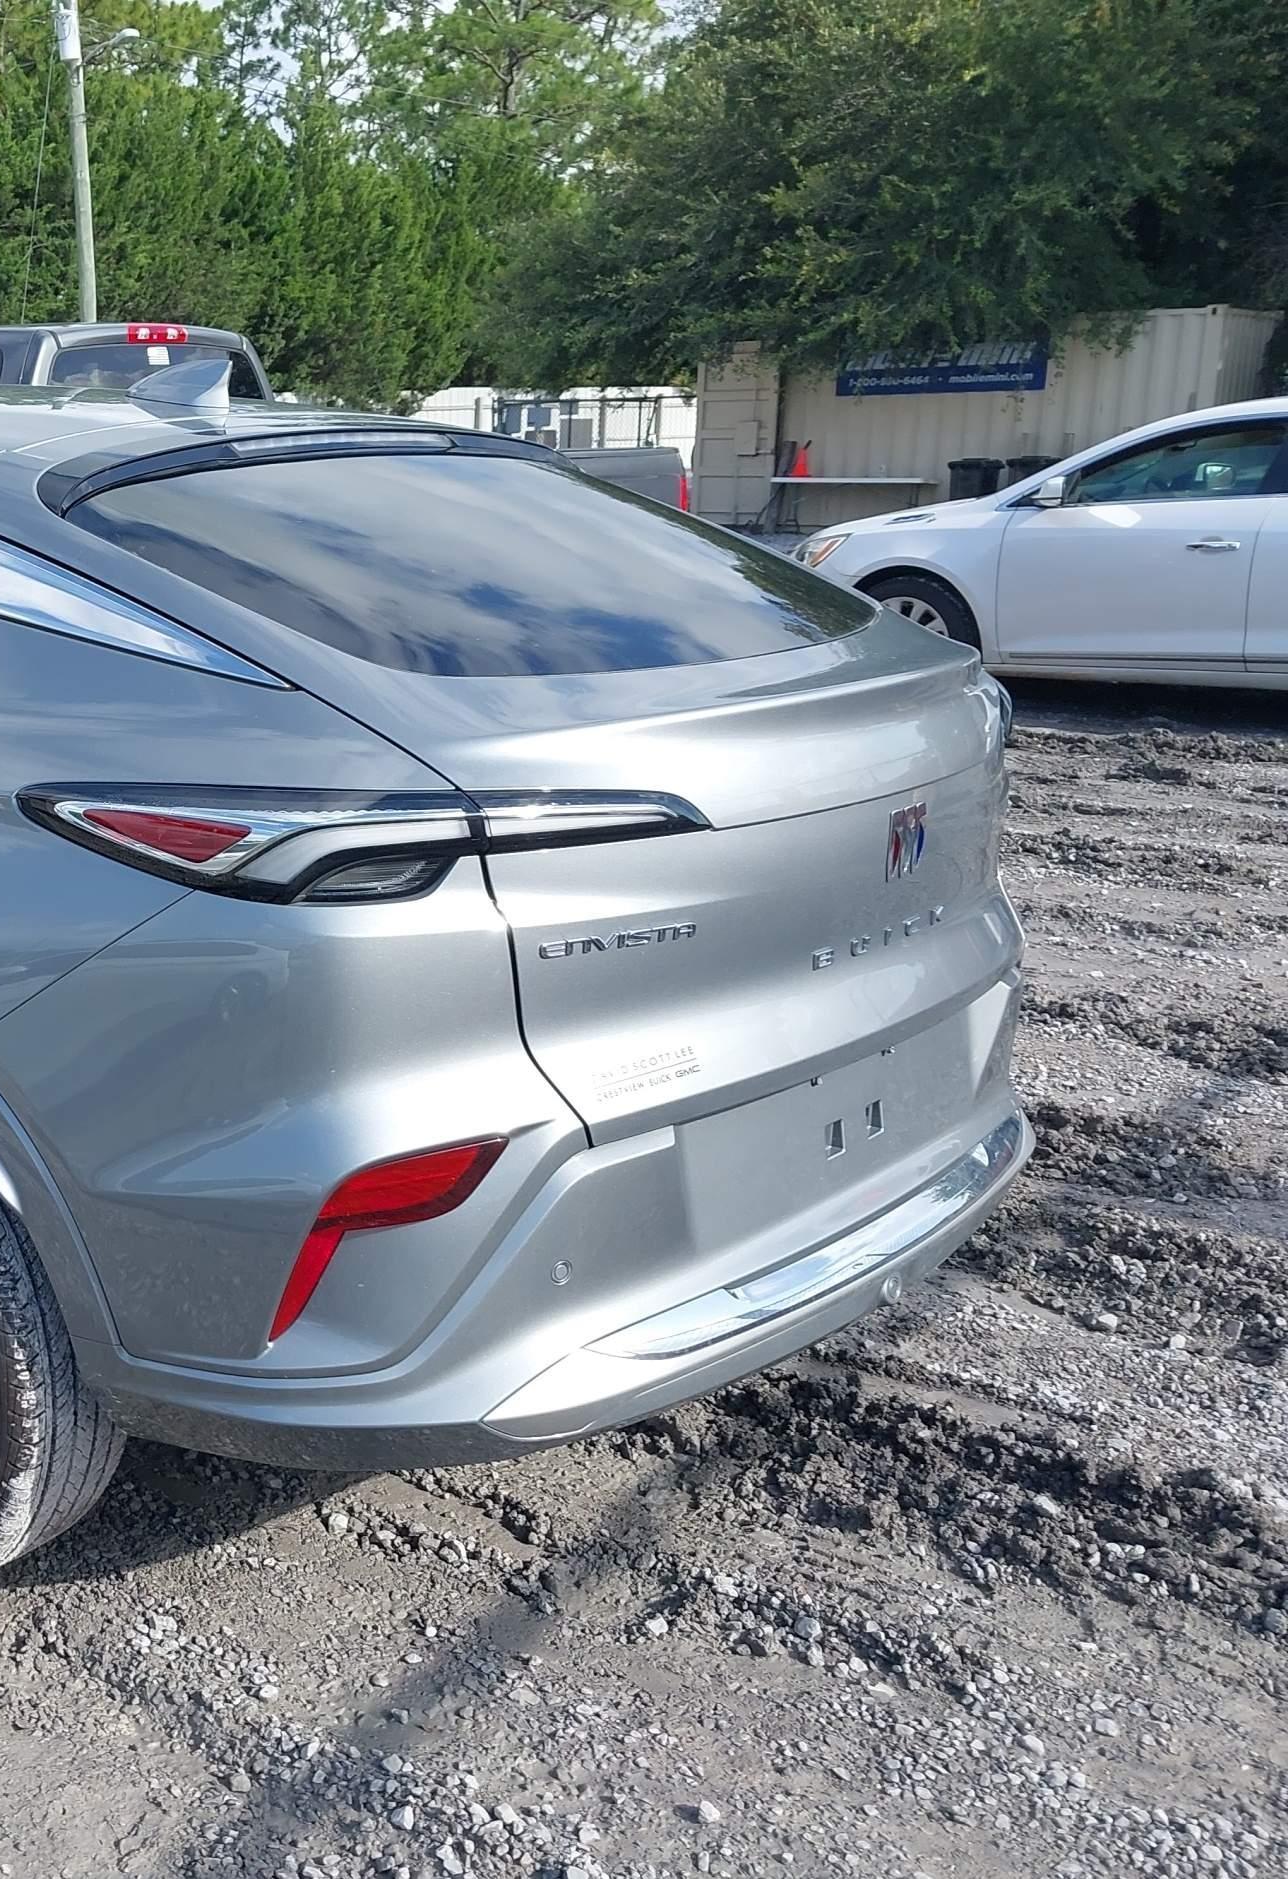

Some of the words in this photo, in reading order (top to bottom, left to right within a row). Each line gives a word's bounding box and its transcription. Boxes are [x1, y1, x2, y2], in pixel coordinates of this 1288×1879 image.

[538, 921, 697, 960] ENVISTA
[812, 905, 945, 971] BUICK
[632, 1052, 671, 1071] SCOTT
[674, 1045, 695, 1059] LEE
[675, 1064, 701, 1078] GMC
